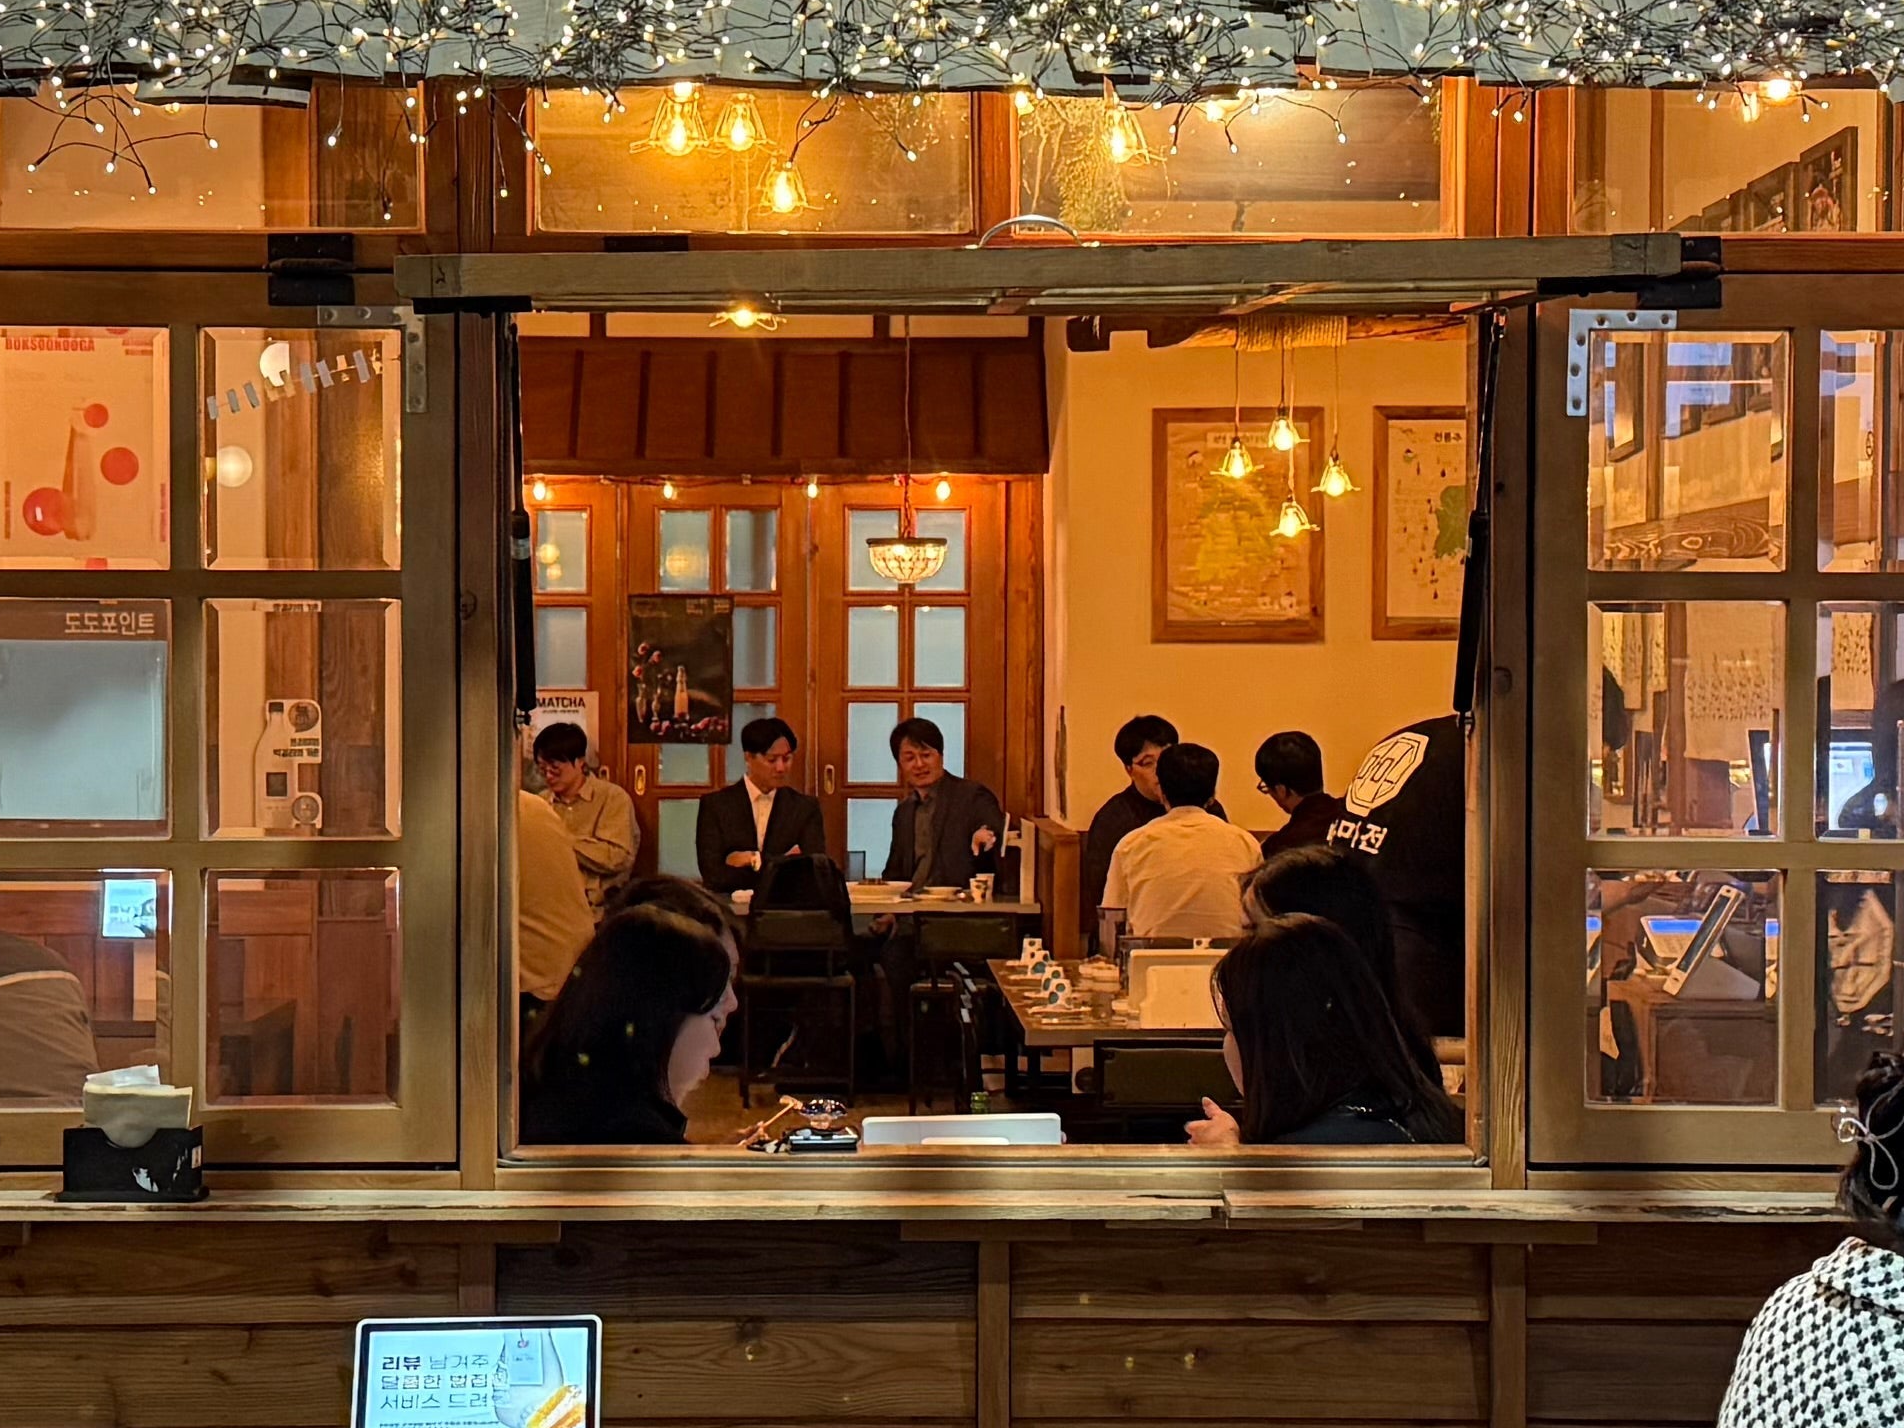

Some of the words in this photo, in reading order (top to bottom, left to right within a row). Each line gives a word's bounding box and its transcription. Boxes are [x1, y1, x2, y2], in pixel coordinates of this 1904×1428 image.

[64, 612, 155, 636] 도도포인트
[536, 696, 586, 709] MATCHA
[381, 1355, 421, 1371] 리뷰
[380, 1393, 441, 1410] 서비스
